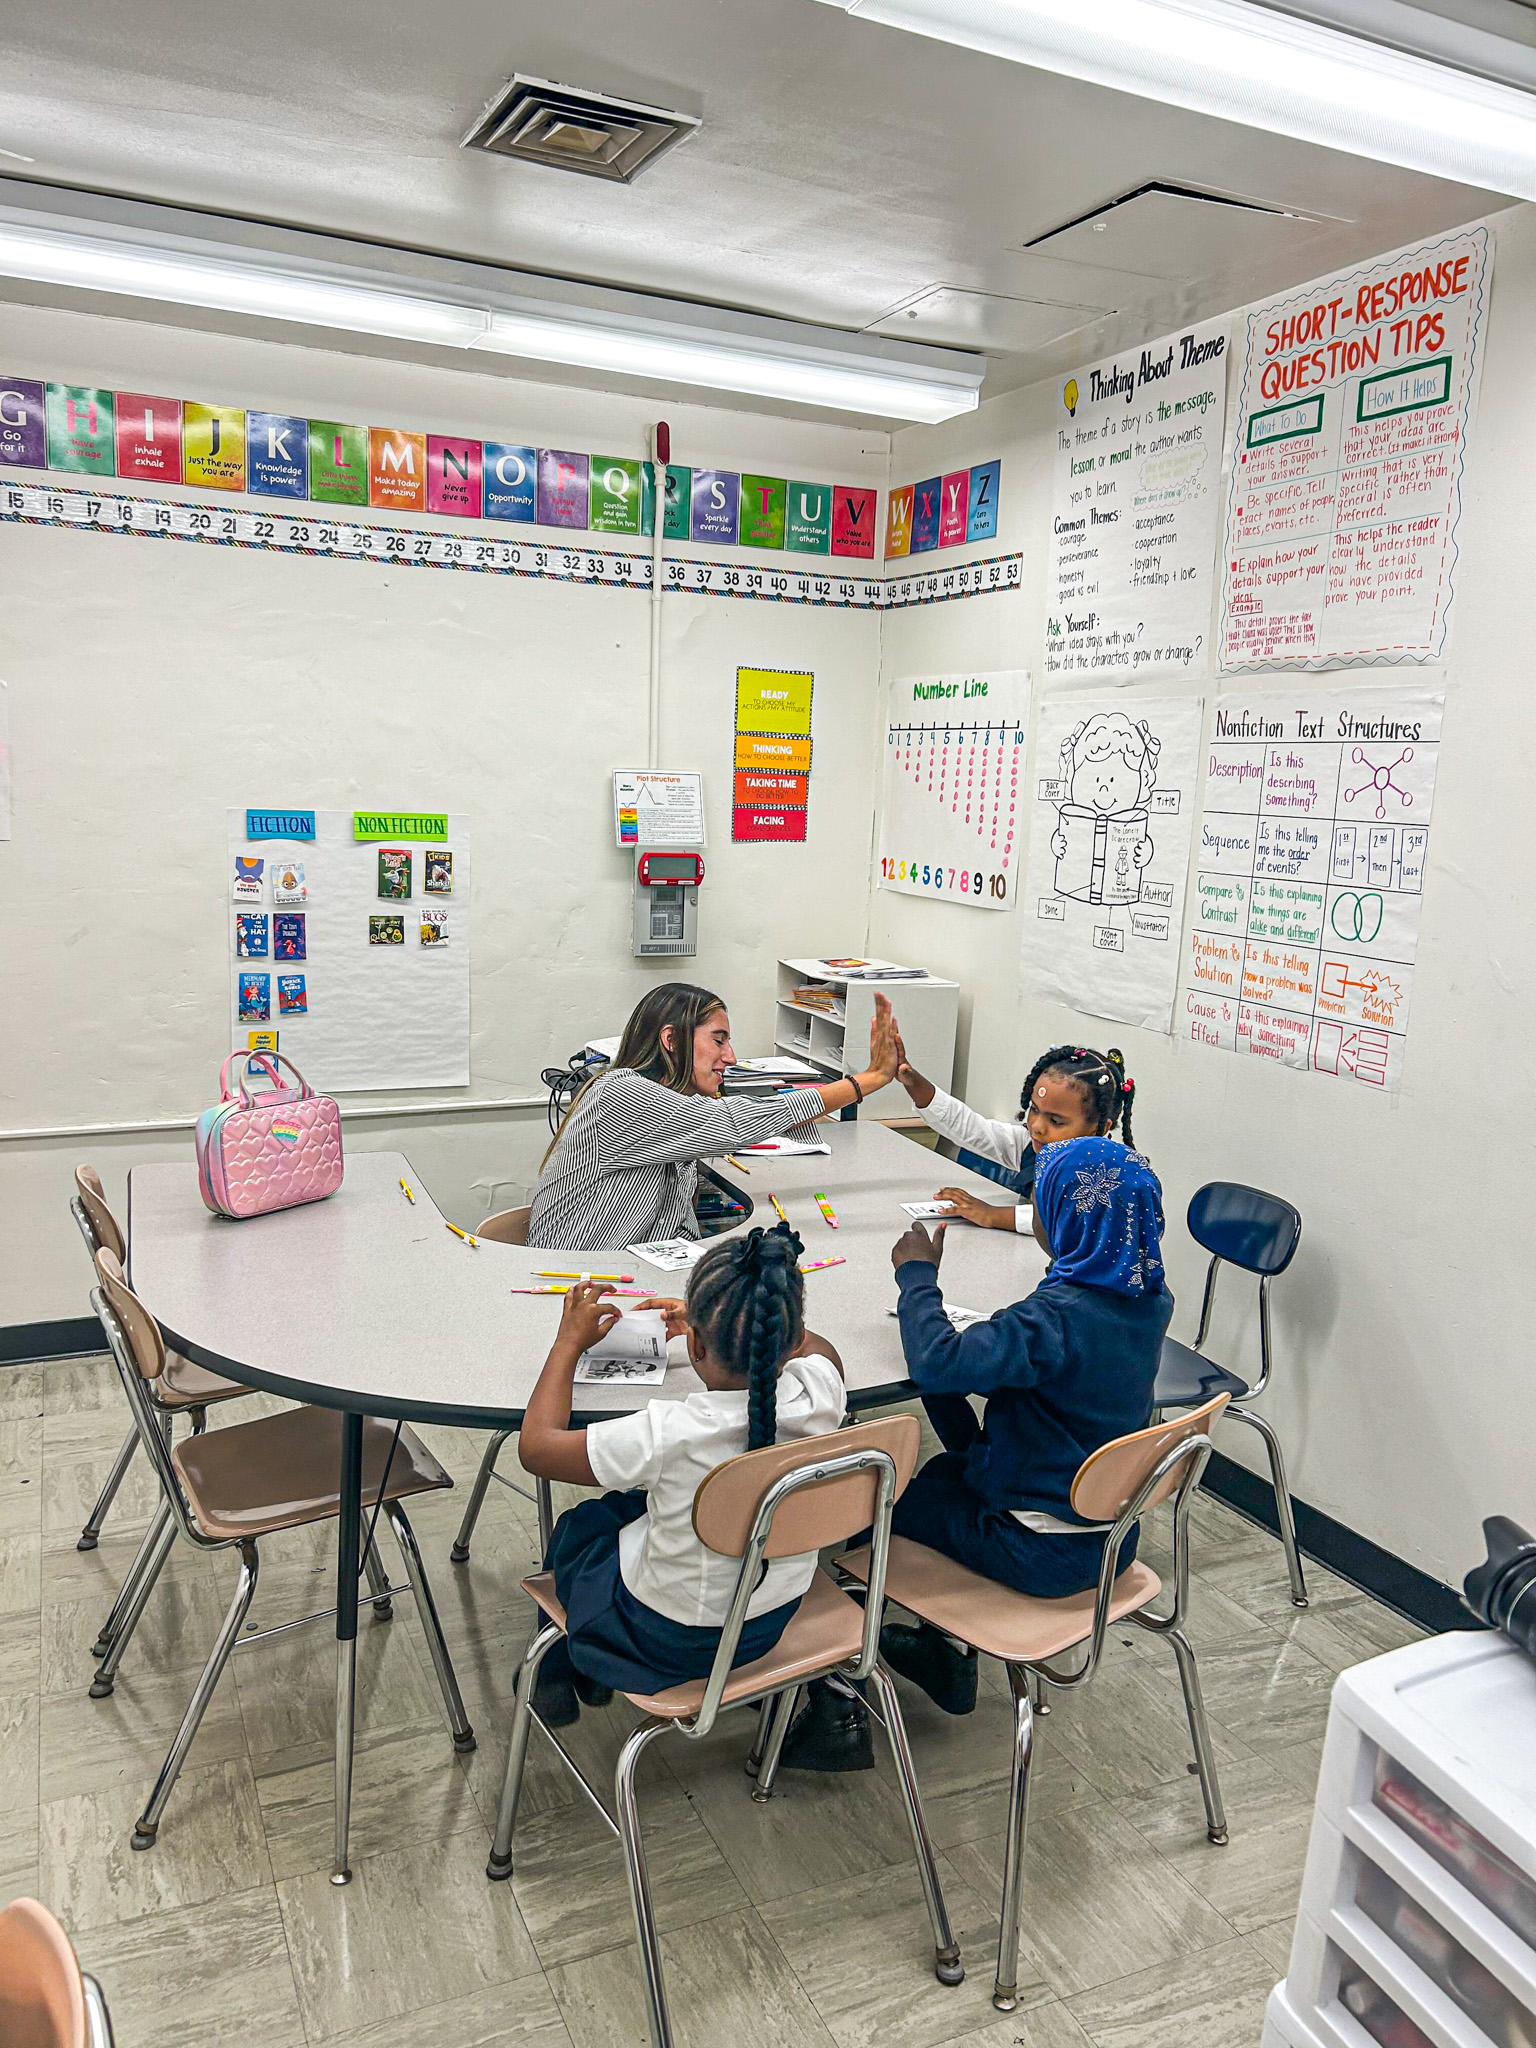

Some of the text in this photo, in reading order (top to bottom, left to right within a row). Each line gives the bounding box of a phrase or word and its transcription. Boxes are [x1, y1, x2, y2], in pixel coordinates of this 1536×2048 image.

[1265, 256, 1469, 356] SHORT-RESPONSE
[1261, 312, 1445, 400] QUESTION TIPS
[1090, 335, 1225, 403] Thinking About Theme
[1367, 377, 1437, 410] How It Helps
[0, 391, 28, 428] G
[67, 400, 97, 435] H
[1058, 390, 1216, 450] The theme of a story is the message,
[3, 430, 21, 442] Go
[1255, 411, 1307, 438] What To Do
[0, 442, 24, 453] for it
[209, 419, 220, 456] J
[268, 427, 292, 461] K
[1250, 436, 1313, 460] Write several
[65, 448, 102, 459] courage
[135, 444, 162, 456] inhale
[334, 436, 351, 468] L
[381, 441, 415, 474] M
[135, 458, 164, 468] exhale
[188, 455, 242, 472] Just the way
[202, 467, 234, 477] you are
[256, 462, 302, 476] Knowledge
[444, 449, 468, 480] N
[495, 455, 526, 486] O
[260, 472, 297, 486] is power
[375, 476, 420, 489] Make today
[444, 484, 467, 493] Never
[558, 463, 576, 492] P
[603, 467, 629, 503] Q
[381, 488, 416, 499] amazing
[442, 492, 469, 503] give up
[488, 493, 533, 505] Opportunity
[710, 481, 726, 510] S
[757, 488, 774, 515] T
[949, 483, 961, 512] Y
[977, 474, 991, 506] Z
[604, 502, 628, 511] Question
[800, 493, 821, 521] U
[846, 498, 866, 525] V
[892, 496, 910, 526] W
[921, 490, 934, 519] X
[700, 523, 732, 534] every day
[705, 514, 729, 523] Sparkle
[792, 525, 826, 535] Understand
[980, 521, 990, 529] hero
[1054, 508, 1122, 534] Common Themes:
[1135, 513, 1175, 530] acceptance
[87, 501, 881, 598] 17 20 22 23 24 26 27 33 34 36 37 38 40 42 43 44
[799, 534, 820, 544] others
[1135, 532, 1177, 551] cooperation
[1332, 532, 1435, 563] clearly understand
[1238, 544, 1319, 574] Explain how your
[887, 564, 1018, 598] 45 50 51 52 53
[1325, 587, 1415, 608] prove your point.
[1047, 613, 1100, 636] Ask Yourself:
[761, 690, 789, 699] READY
[913, 679, 988, 701] Number Line
[1216, 710, 1422, 740] Nonfiction Text Structures
[753, 744, 792, 754] THINKING
[1209, 756, 1263, 784] Description
[746, 778, 797, 788] TAKING TIME
[1268, 776, 1315, 795] describing
[1157, 797, 1176, 806] Title
[1266, 792, 1317, 812] something?
[251, 817, 311, 833] FICTION
[754, 816, 784, 825] FACING
[1203, 825, 1250, 857] Sequence
[427, 879, 450, 887] Sharks!
[881, 857, 1006, 899] 1 2 3 4 5 6 7 8 9 10
[1403, 867, 1419, 876] Last
[1144, 889, 1171, 902] Author
[1198, 875, 1233, 899] Compare
[422, 913, 448, 922] BUGS
[1201, 900, 1238, 923] Contrast
[1192, 935, 1228, 960] Problem
[1194, 957, 1233, 985] Solution
[1186, 994, 1217, 1020] Cause
[1191, 1022, 1220, 1045] Effect
